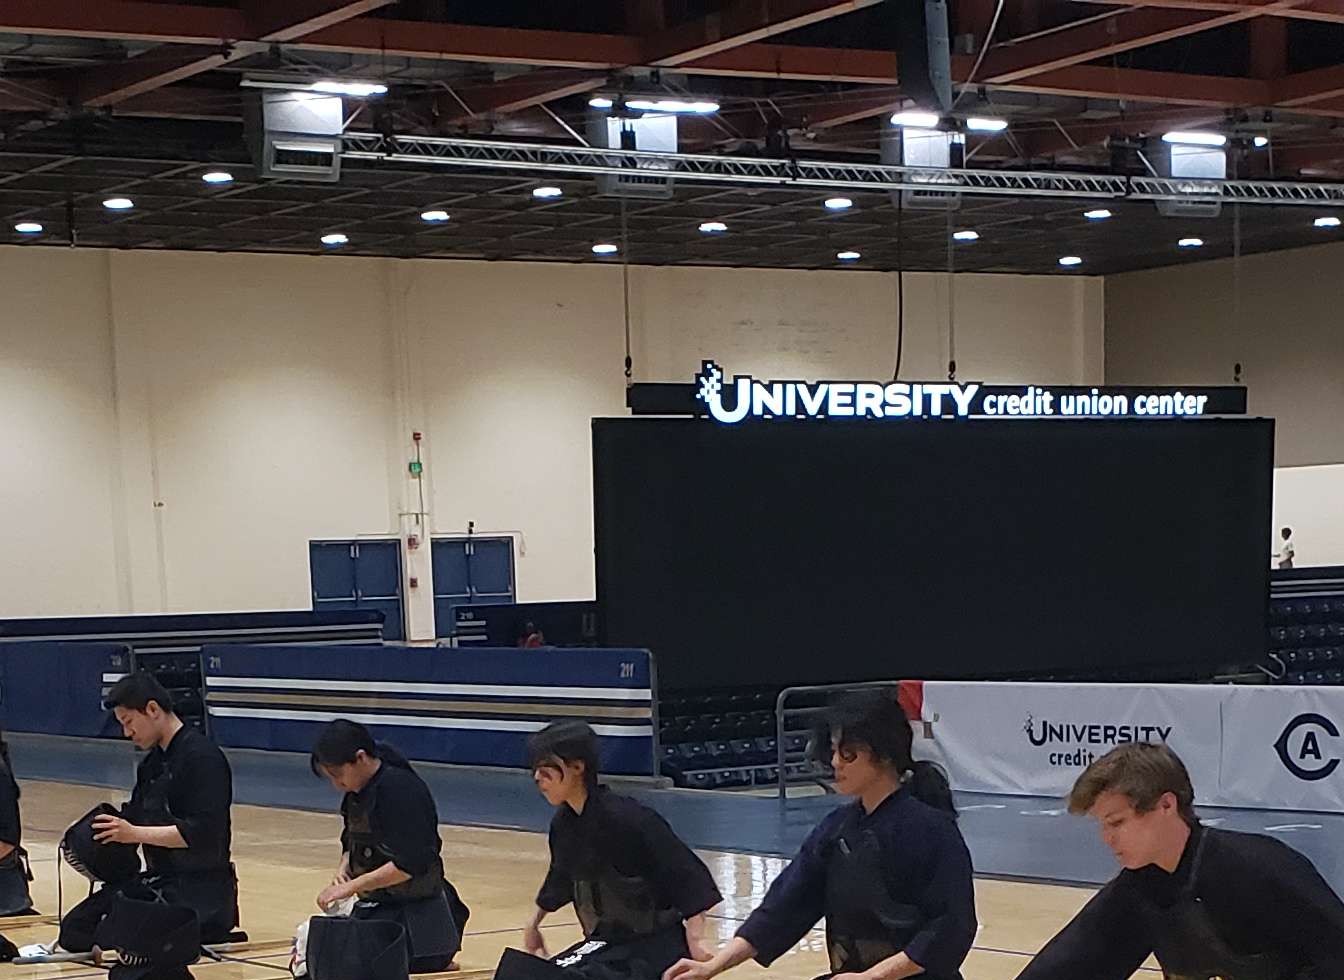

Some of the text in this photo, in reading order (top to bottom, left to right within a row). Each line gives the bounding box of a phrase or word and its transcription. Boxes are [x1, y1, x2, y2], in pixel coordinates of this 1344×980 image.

[696, 366, 1208, 423] UNIVERSITY credit union center
[1024, 712, 1172, 746] UNIVERSITY
[1049, 749, 1095, 766] credit
